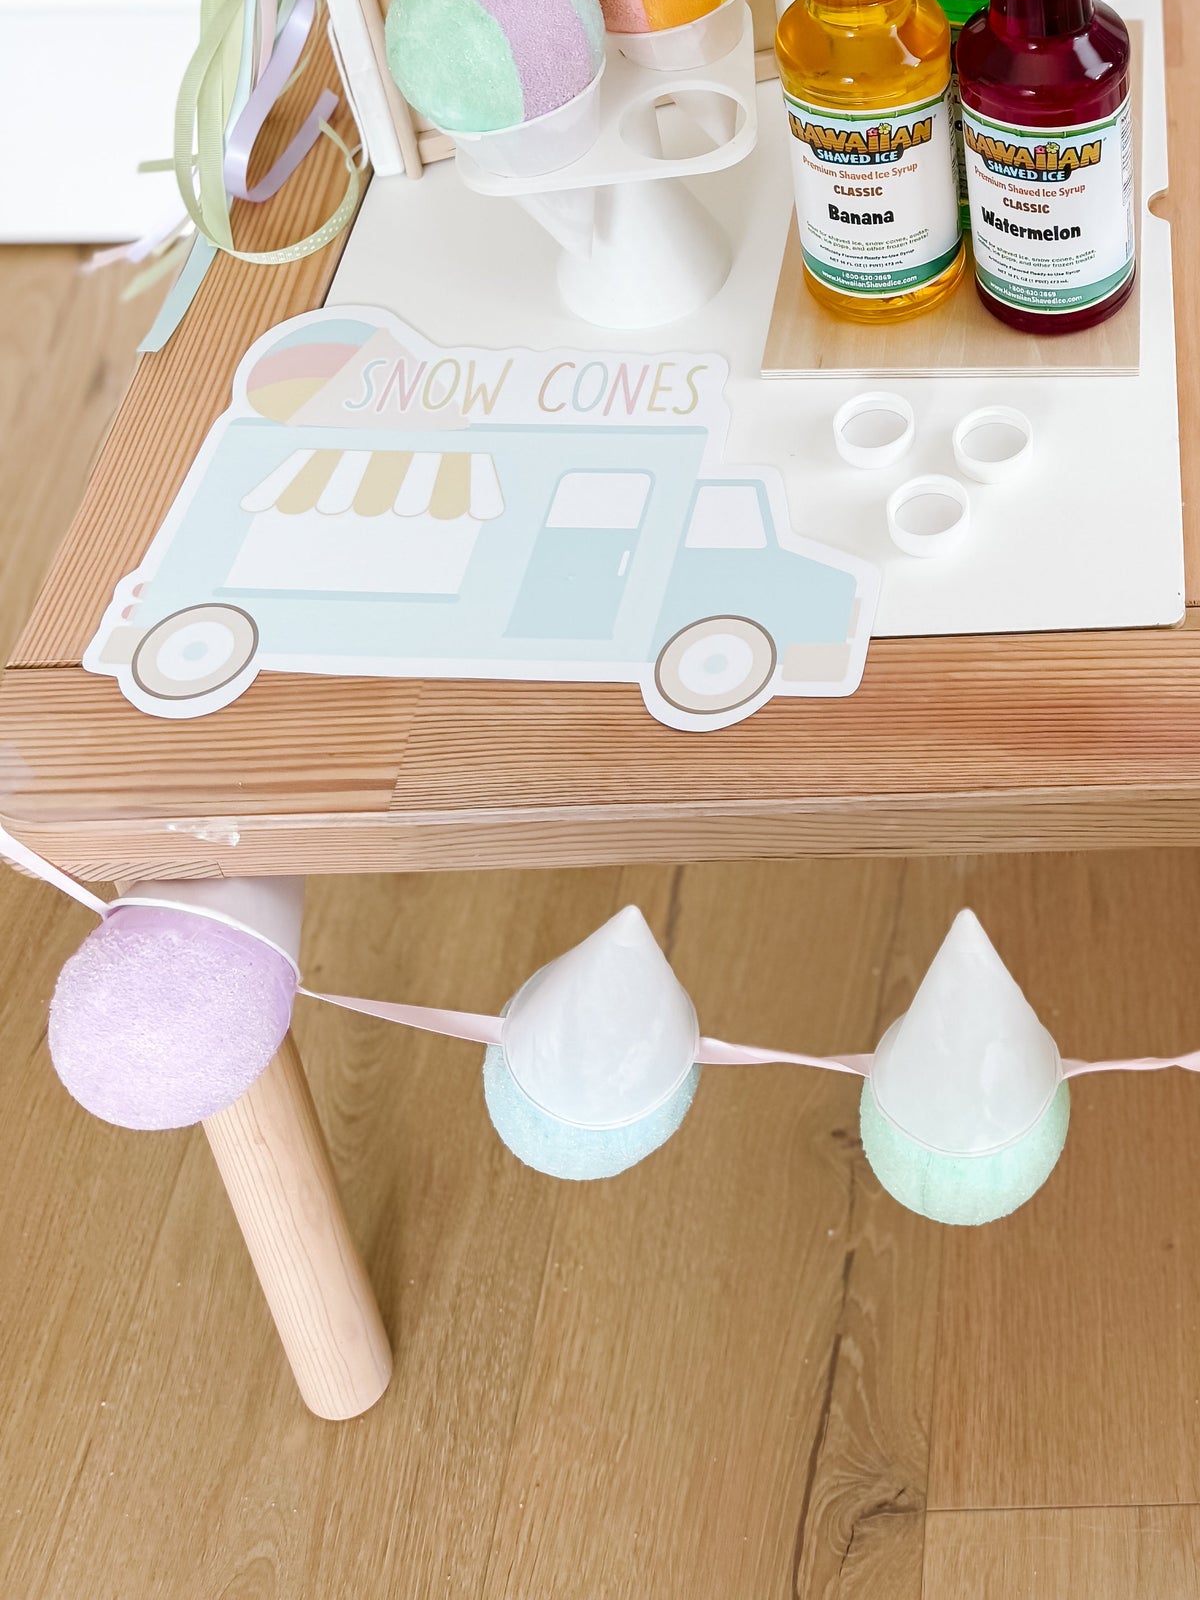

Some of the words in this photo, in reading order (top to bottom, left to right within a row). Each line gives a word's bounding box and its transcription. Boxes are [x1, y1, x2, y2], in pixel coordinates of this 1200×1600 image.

[788, 110, 934, 154] HAWAIIAN
[816, 149, 871, 164] SHAVED
[875, 150, 899, 163] ICE
[963, 125, 1103, 172] HAWAIIAN
[802, 155, 838, 178] Premium
[839, 170, 874, 181] Shaved
[875, 170, 890, 180] Ice
[891, 162, 918, 177] Syrup
[987, 160, 1038, 181] SHAVED
[1042, 170, 1066, 181] ICE
[833, 184, 884, 197] CLASSIC
[974, 165, 1007, 190] Premium
[1008, 183, 1041, 198] Shaved
[1042, 188, 1057, 198] Ice
[1058, 184, 1087, 199] Syrup
[828, 203, 895, 226] Banana
[1002, 196, 1050, 214] CLASSIC
[980, 205, 1082, 242] Watermelon
[344, 357, 515, 416] SNOW
[538, 360, 709, 417] CONES
